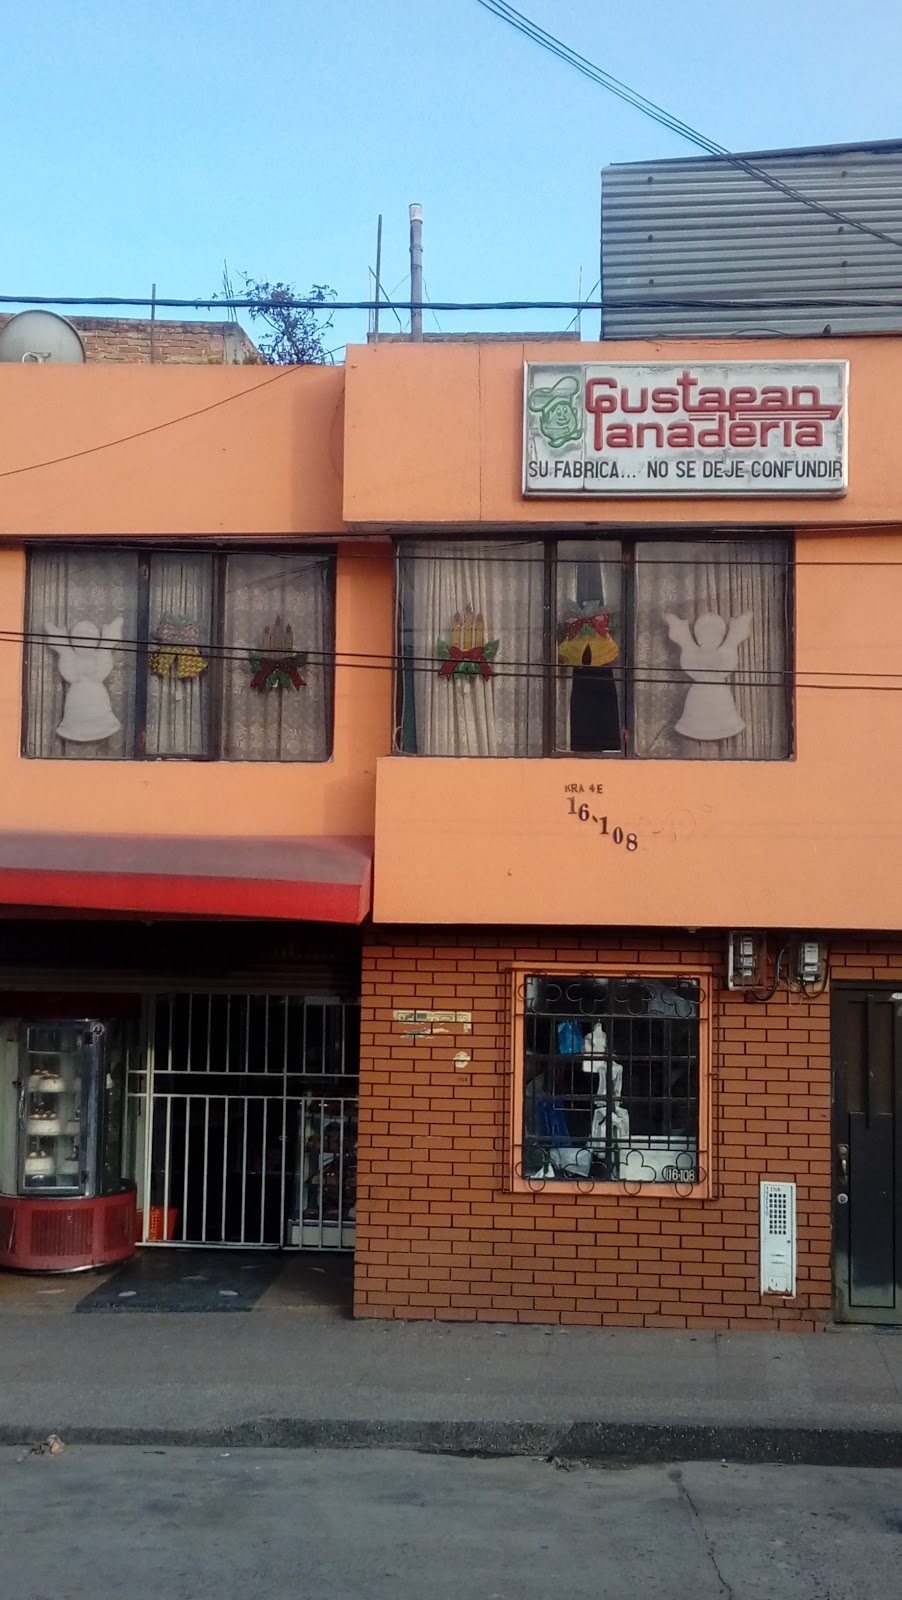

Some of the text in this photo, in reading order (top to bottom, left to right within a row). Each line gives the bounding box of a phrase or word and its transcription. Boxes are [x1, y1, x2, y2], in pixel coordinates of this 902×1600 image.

[586, 370, 843, 420] Gustapan
[529, 460, 843, 479] SU FABRICA... NO SE DEJE CONFUNDIR
[564, 783, 585, 793] KRA
